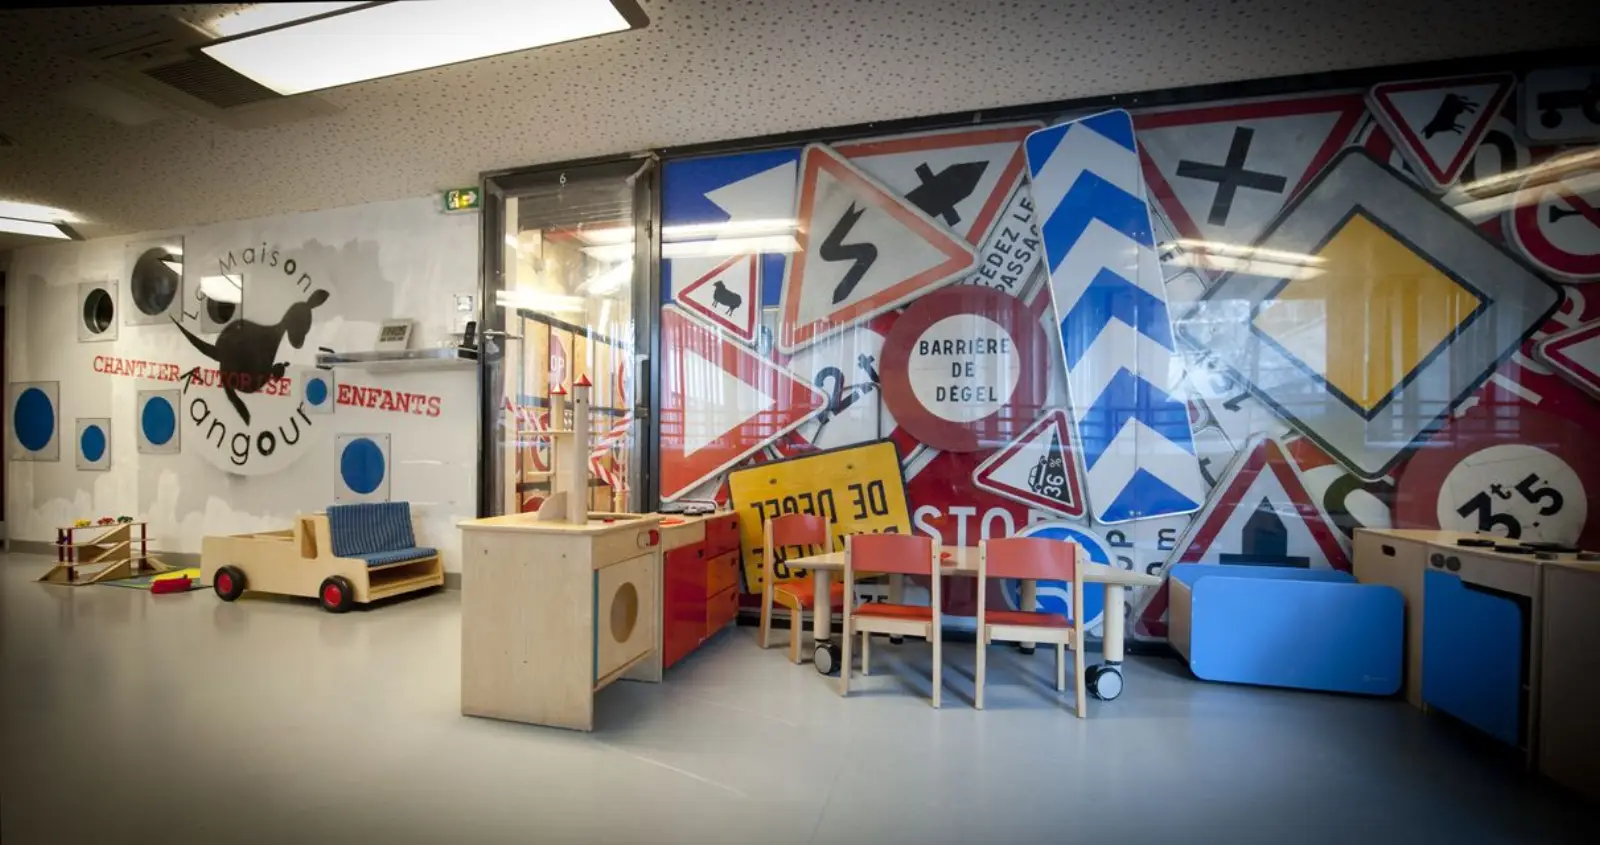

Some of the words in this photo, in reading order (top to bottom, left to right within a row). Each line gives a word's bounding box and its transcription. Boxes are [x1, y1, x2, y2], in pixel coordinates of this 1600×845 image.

[219, 242, 312, 293] Maison
[994, 224, 1040, 293] PASSA
[93, 355, 181, 382] CHANTIER
[336, 383, 442, 417] ENFANTS
[951, 361, 975, 377] DE
[848, 479, 889, 519] DE
[913, 504, 1053, 548] STO
